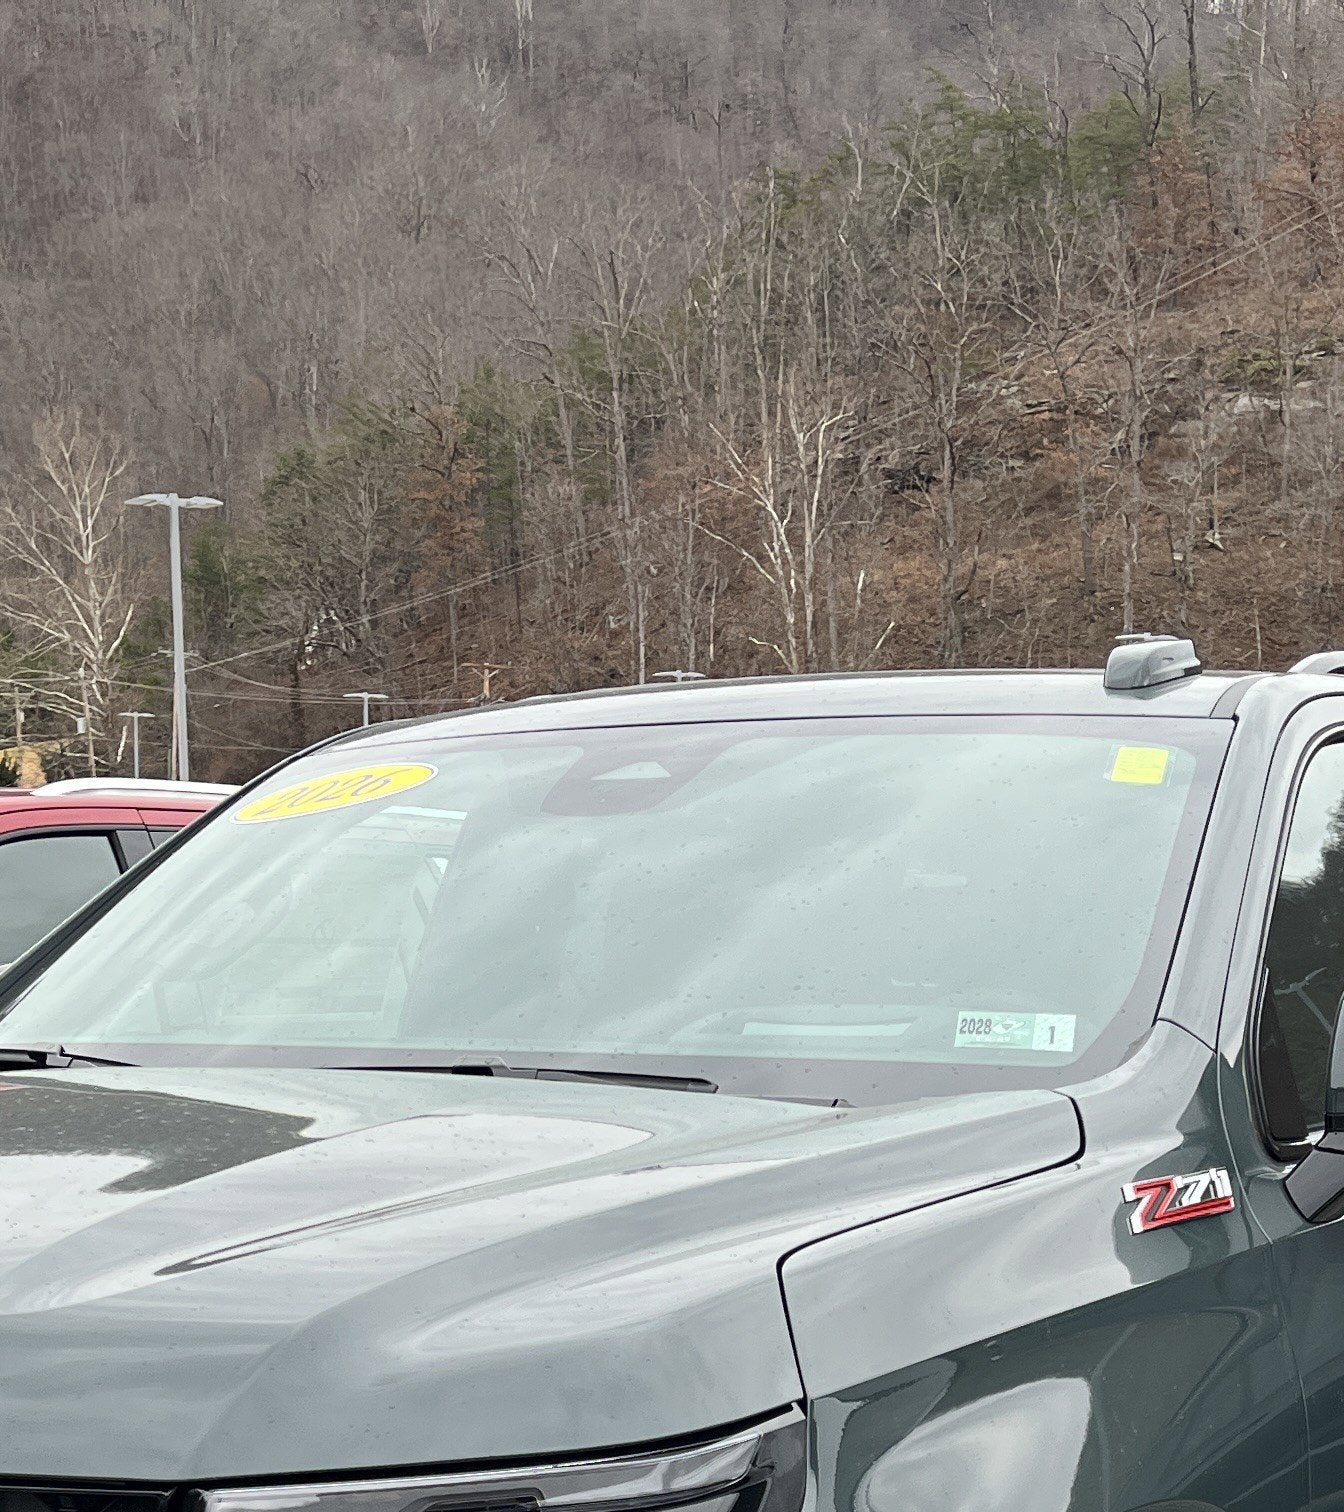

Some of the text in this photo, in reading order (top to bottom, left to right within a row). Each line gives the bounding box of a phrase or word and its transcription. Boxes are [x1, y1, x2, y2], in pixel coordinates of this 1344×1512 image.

[252, 767, 413, 816] 2026
[958, 1018, 993, 1035] 2028
[1048, 1025, 1057, 1045] 1
[1120, 1167, 1236, 1235] Z71
